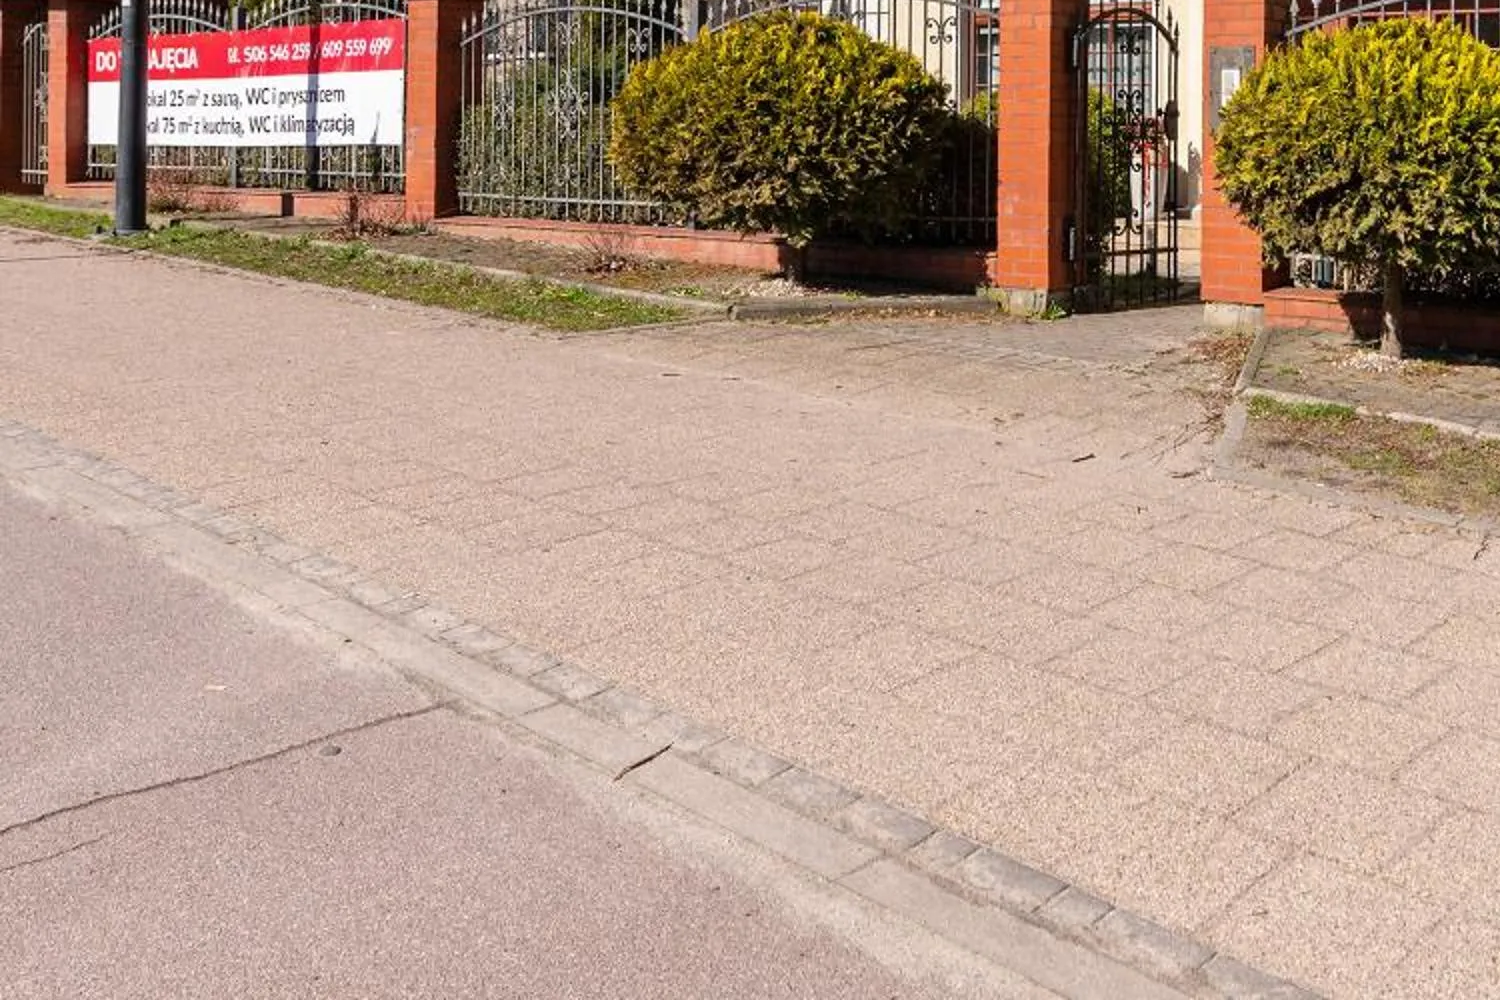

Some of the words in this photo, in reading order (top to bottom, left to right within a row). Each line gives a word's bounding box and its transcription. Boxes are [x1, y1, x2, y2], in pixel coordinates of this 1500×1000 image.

[96, 51, 117, 72] DO
[243, 45, 267, 63] 506
[269, 43, 290, 61] 546
[322, 39, 343, 58] 609
[345, 39, 367, 57] 559
[369, 36, 393, 56] 699
[147, 89, 167, 107] okal
[169, 89, 185, 107] 25
[202, 93, 209, 107] z
[245, 87, 270, 105] WC
[162, 117, 176, 134] 75
[194, 121, 201, 135] z
[248, 115, 272, 134] WC
